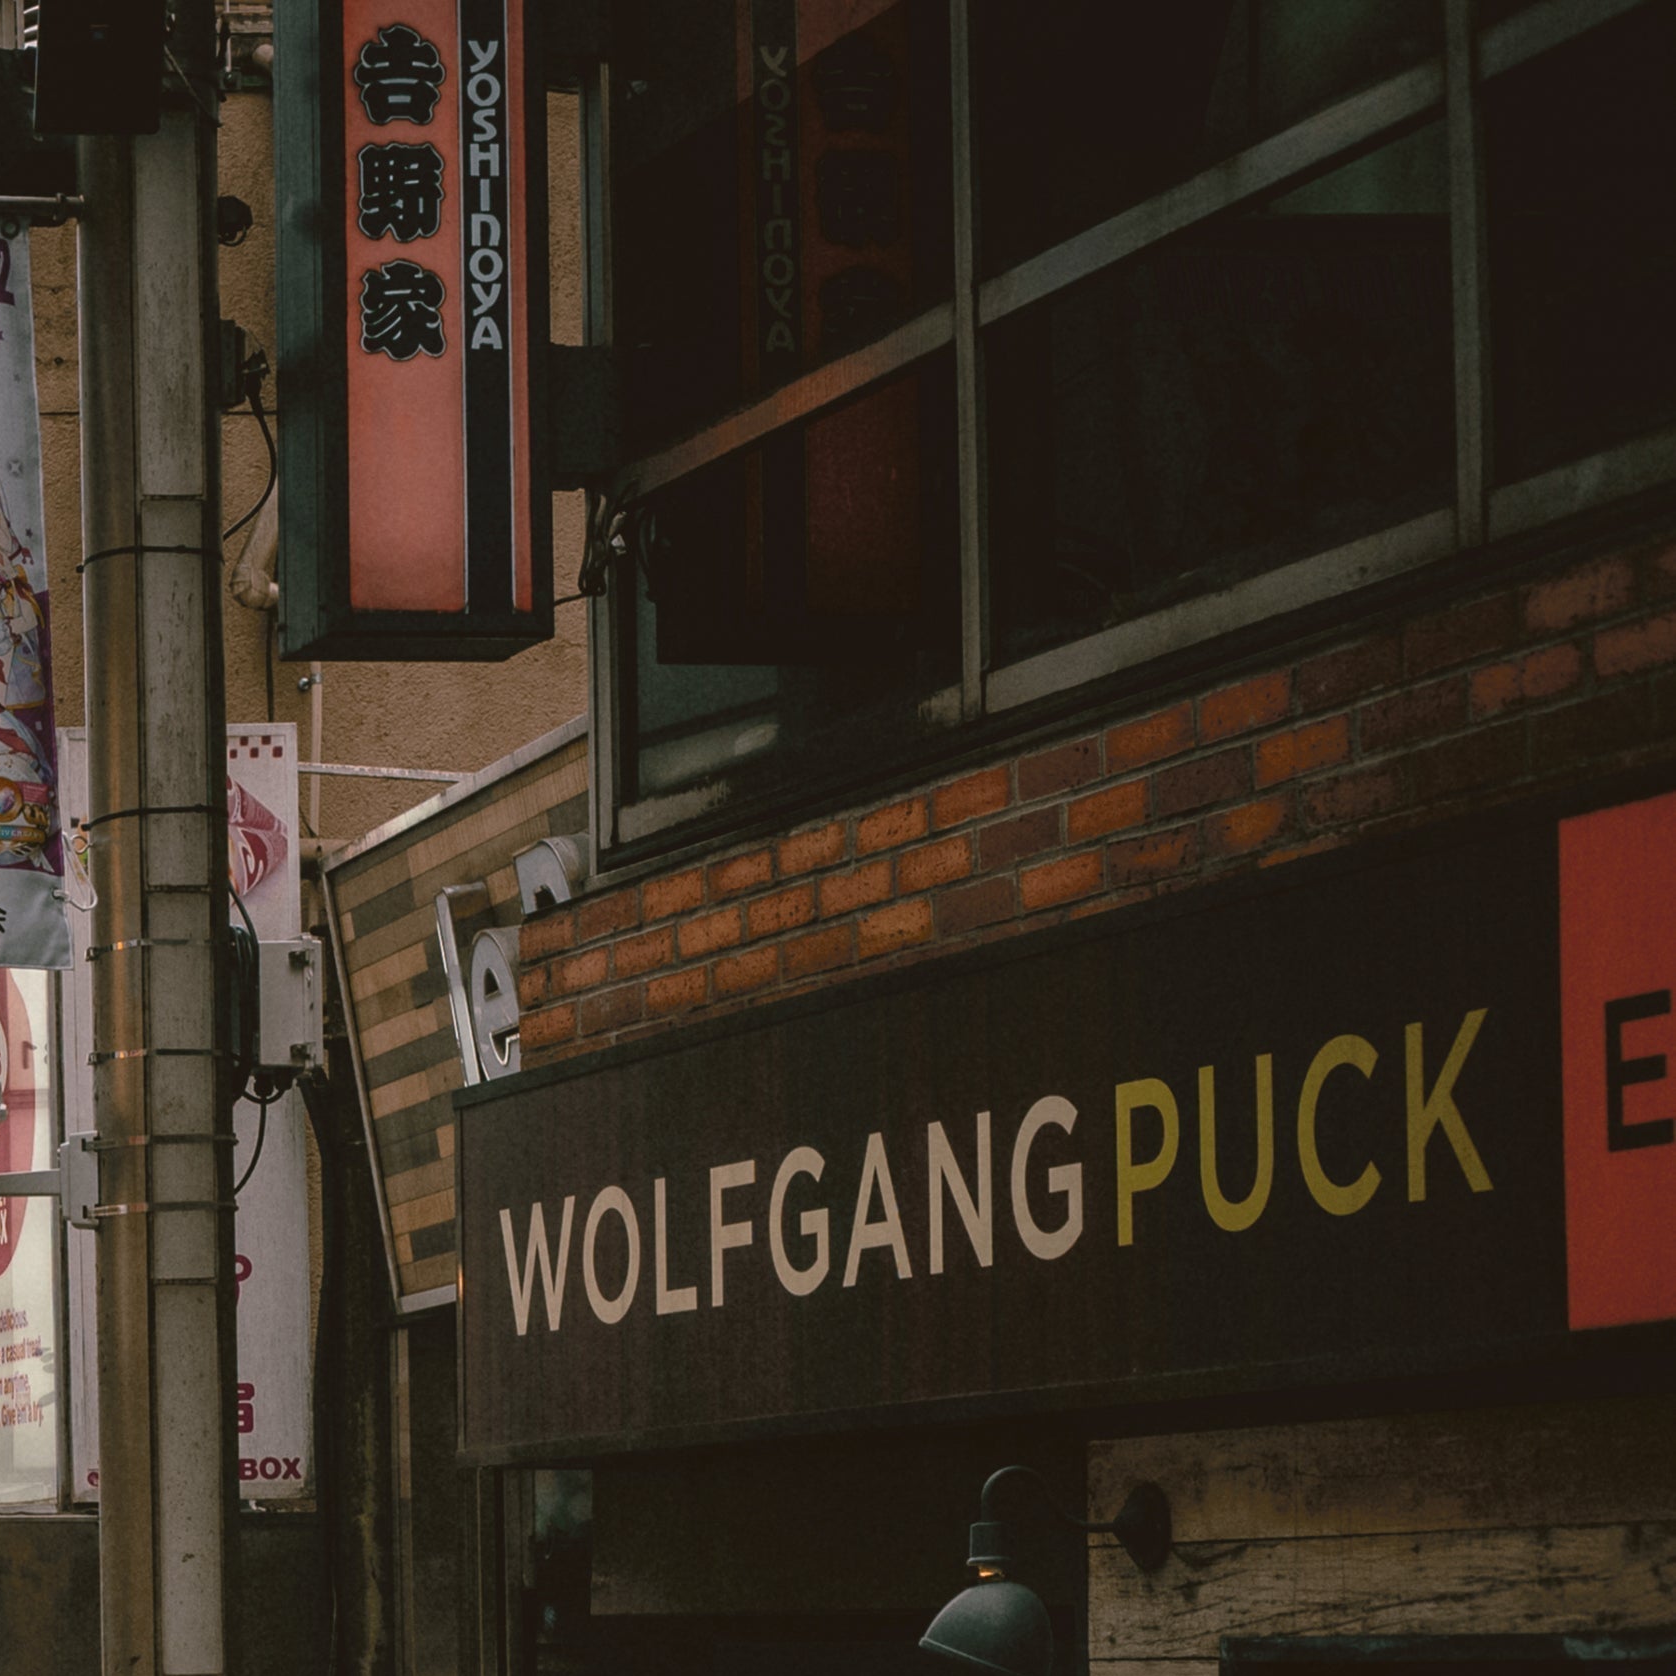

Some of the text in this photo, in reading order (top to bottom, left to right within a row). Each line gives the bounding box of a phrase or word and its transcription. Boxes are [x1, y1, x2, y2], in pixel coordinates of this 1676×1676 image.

[353, 23, 447, 361] 吉野家
[469, 40, 504, 350] YOSHINOYA
[239, 1457, 303, 1482] BOX
